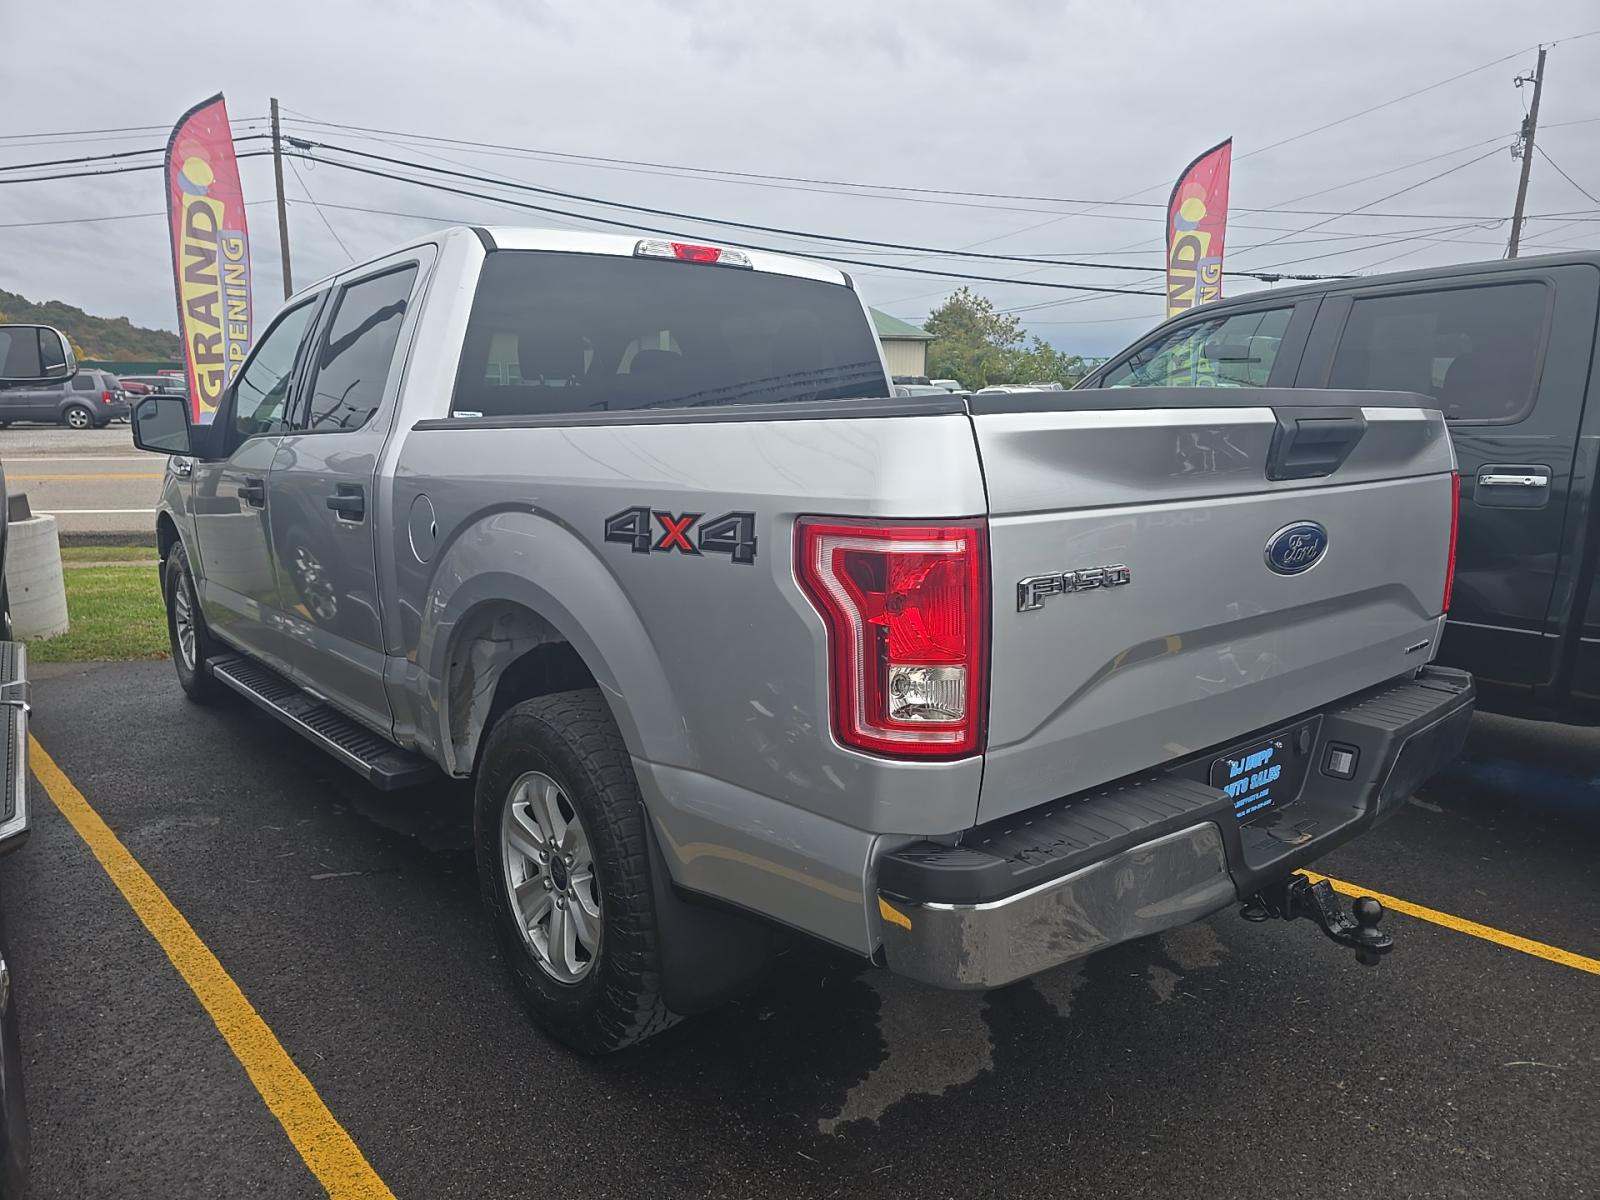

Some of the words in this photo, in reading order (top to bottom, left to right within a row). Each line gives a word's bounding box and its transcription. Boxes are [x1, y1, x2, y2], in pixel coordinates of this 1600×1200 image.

[185, 200, 225, 408] GRAND
[604, 505, 758, 566] 4X4
[1250, 764, 1282, 790] SALES
